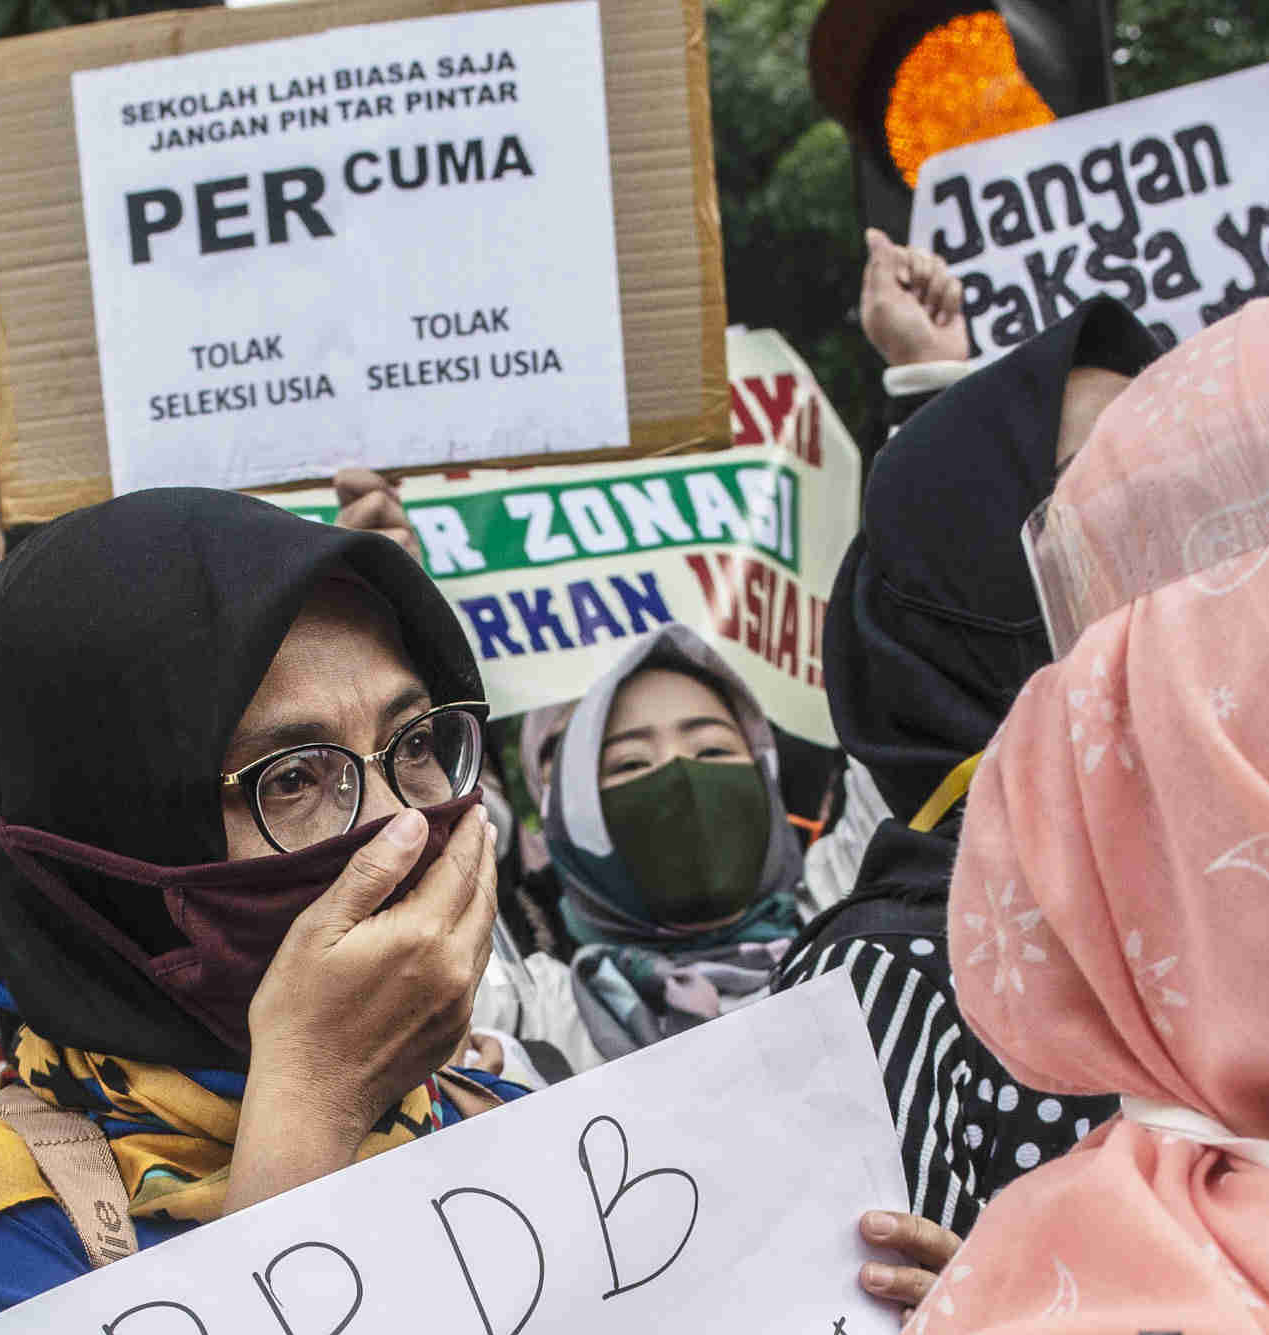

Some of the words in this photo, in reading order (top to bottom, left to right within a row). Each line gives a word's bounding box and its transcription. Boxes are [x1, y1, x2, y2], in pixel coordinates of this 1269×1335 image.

[121, 85, 258, 126] SEKOLAH
[268, 75, 327, 104] LAH
[335, 60, 427, 92] BIASA
[436, 50, 517, 79] SAJA
[150, 115, 270, 152] JANGAN
[406, 81, 518, 114] PINTAR
[931, 122, 1231, 265] Jangan
[412, 306, 510, 341] TOLAK
[191, 335, 284, 372] TOLAK
[367, 355, 481, 391] SELEKSI
[490, 348, 563, 379] USIA
[150, 385, 257, 421] SELEKSI
[266, 373, 336, 406] USIA
[502, 466, 794, 564] ZONASI
